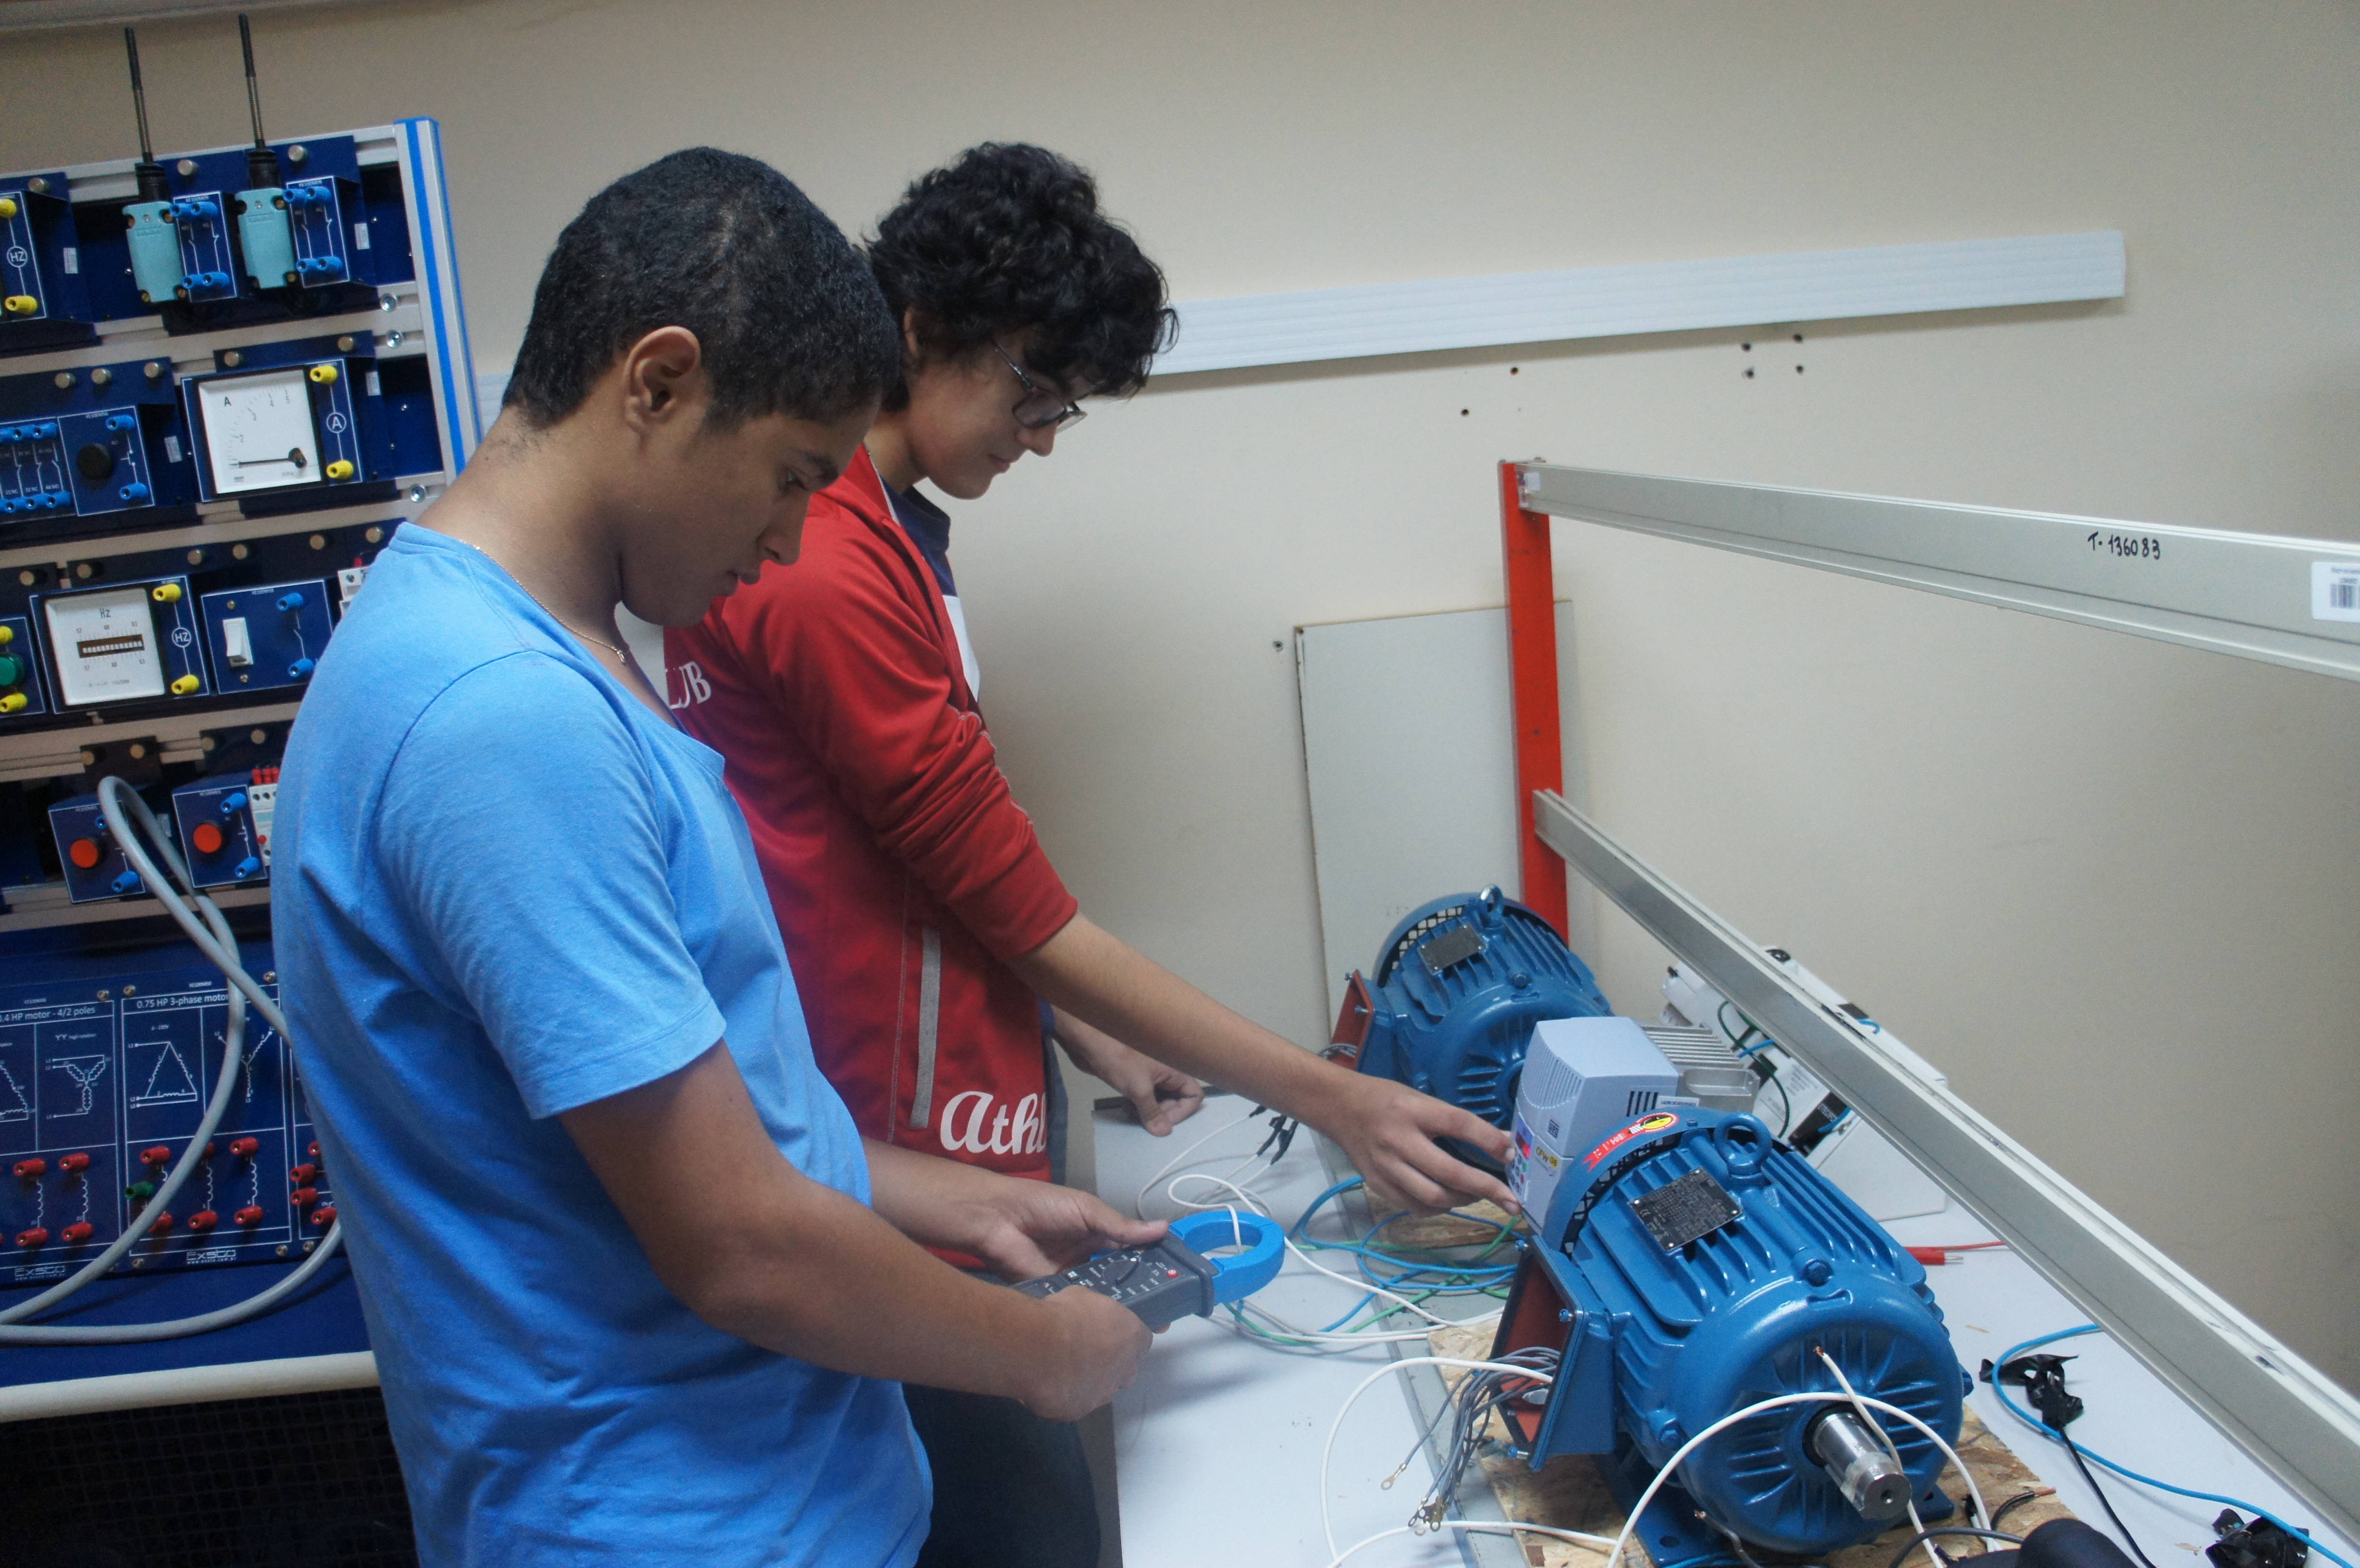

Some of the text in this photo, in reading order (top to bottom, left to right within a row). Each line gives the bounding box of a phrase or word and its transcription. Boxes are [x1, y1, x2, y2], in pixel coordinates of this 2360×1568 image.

[224, 396, 232, 407] A
[332, 416, 343, 429] A
[100, 607, 111, 618] Hz
[174, 633, 190, 643] HZ
[136, 998, 154, 1008] 0.75
[157, 999, 168, 1007] HP
[170, 996, 202, 1006] 3-phase
[12, 1013, 23, 1021] HP
[25, 1011, 50, 1019] motor
[58, 1008, 72, 1017] 4/2
[74, 1006, 96, 1017] poles
